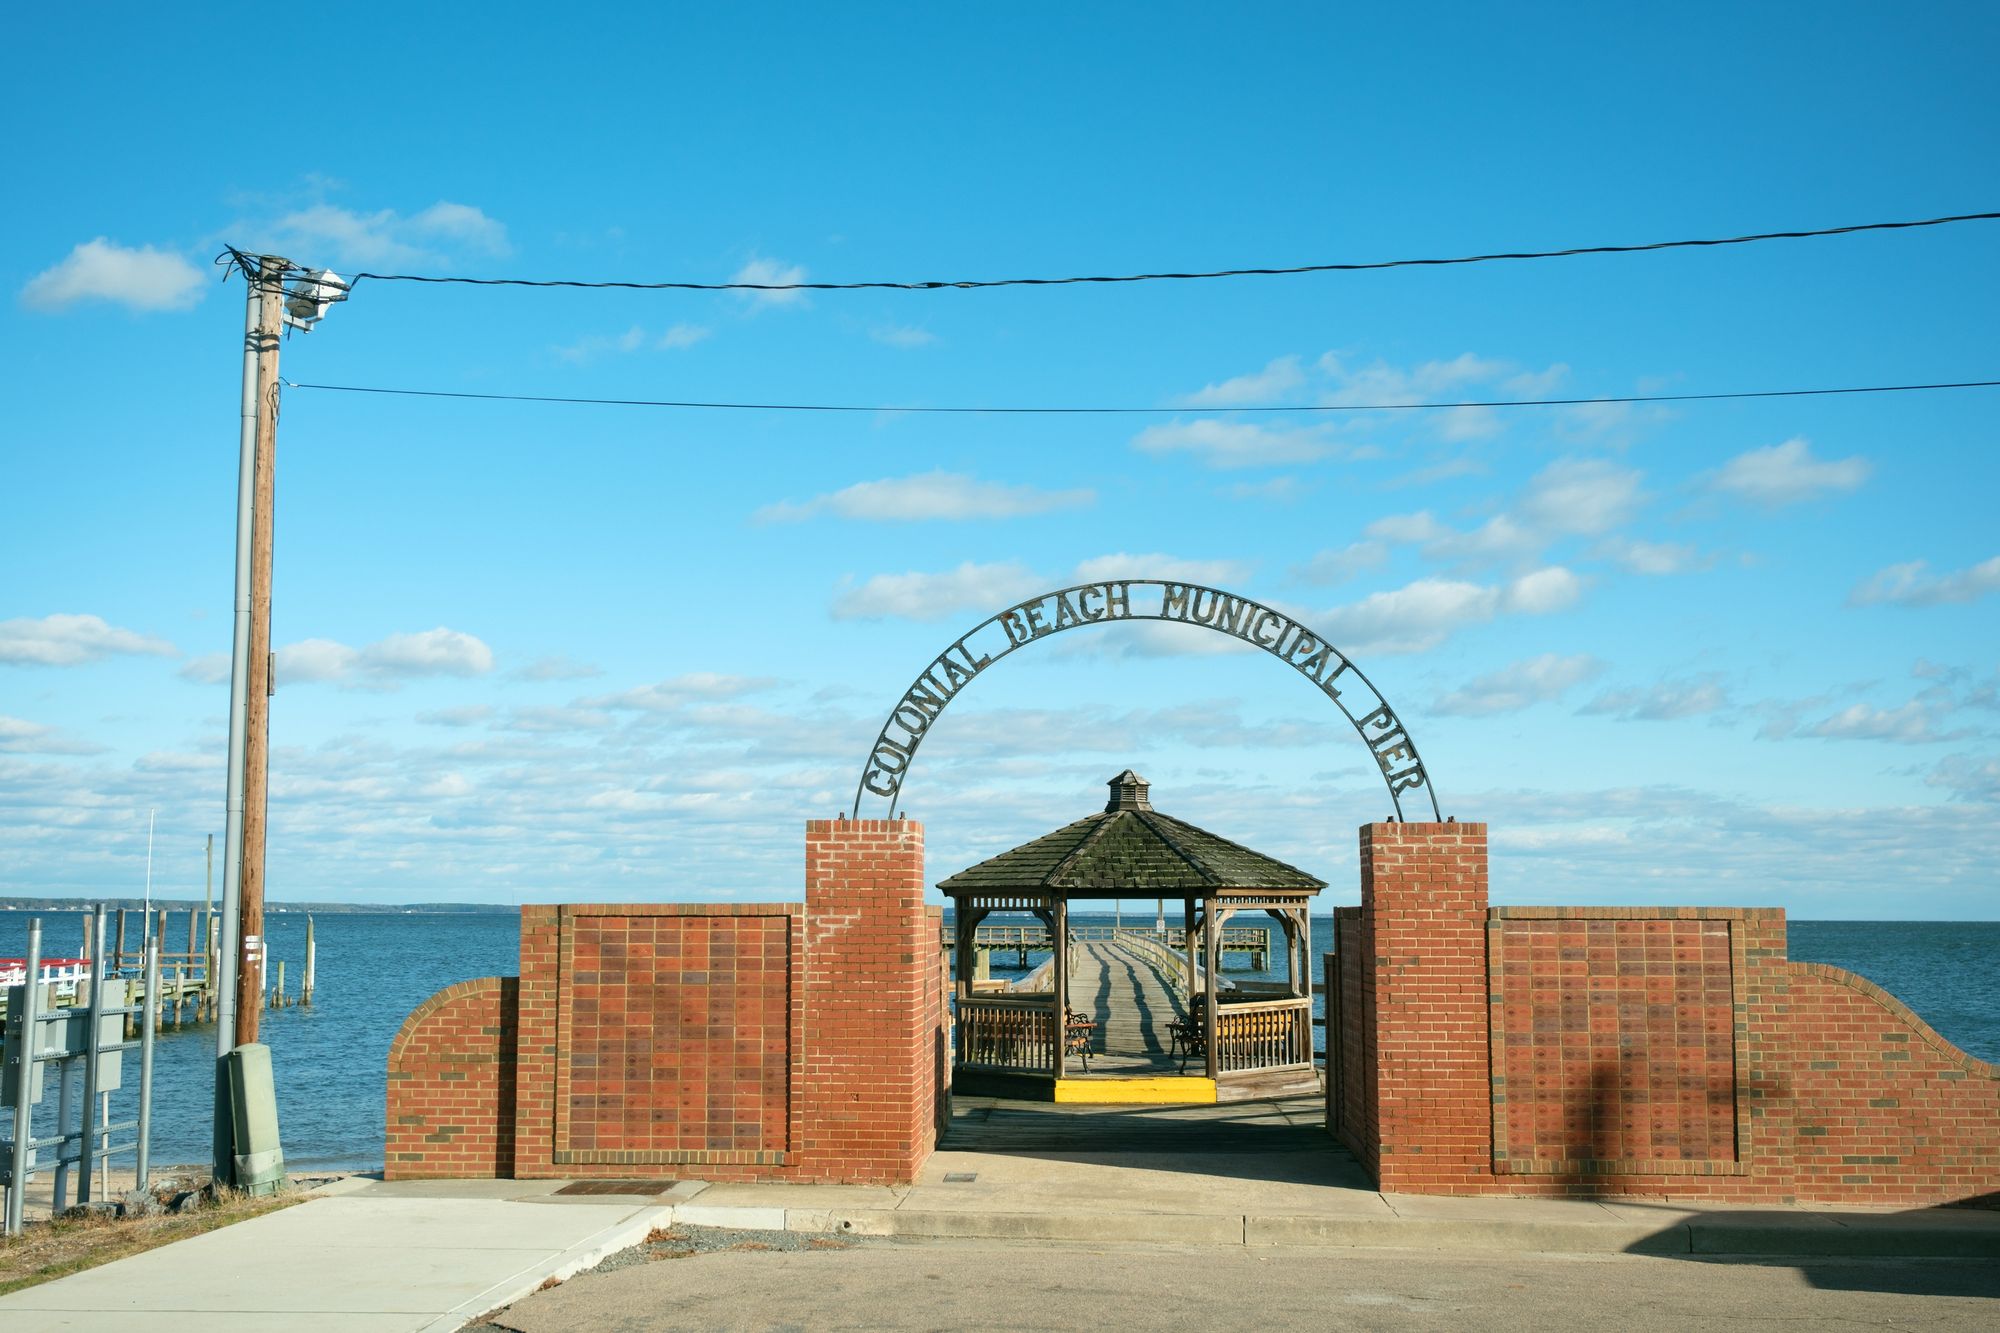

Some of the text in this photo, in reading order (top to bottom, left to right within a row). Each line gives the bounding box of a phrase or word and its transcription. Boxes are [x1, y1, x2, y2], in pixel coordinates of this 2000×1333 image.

[864, 584, 1424, 798] COLONIAL BEACH MUNICIPAL PIER
